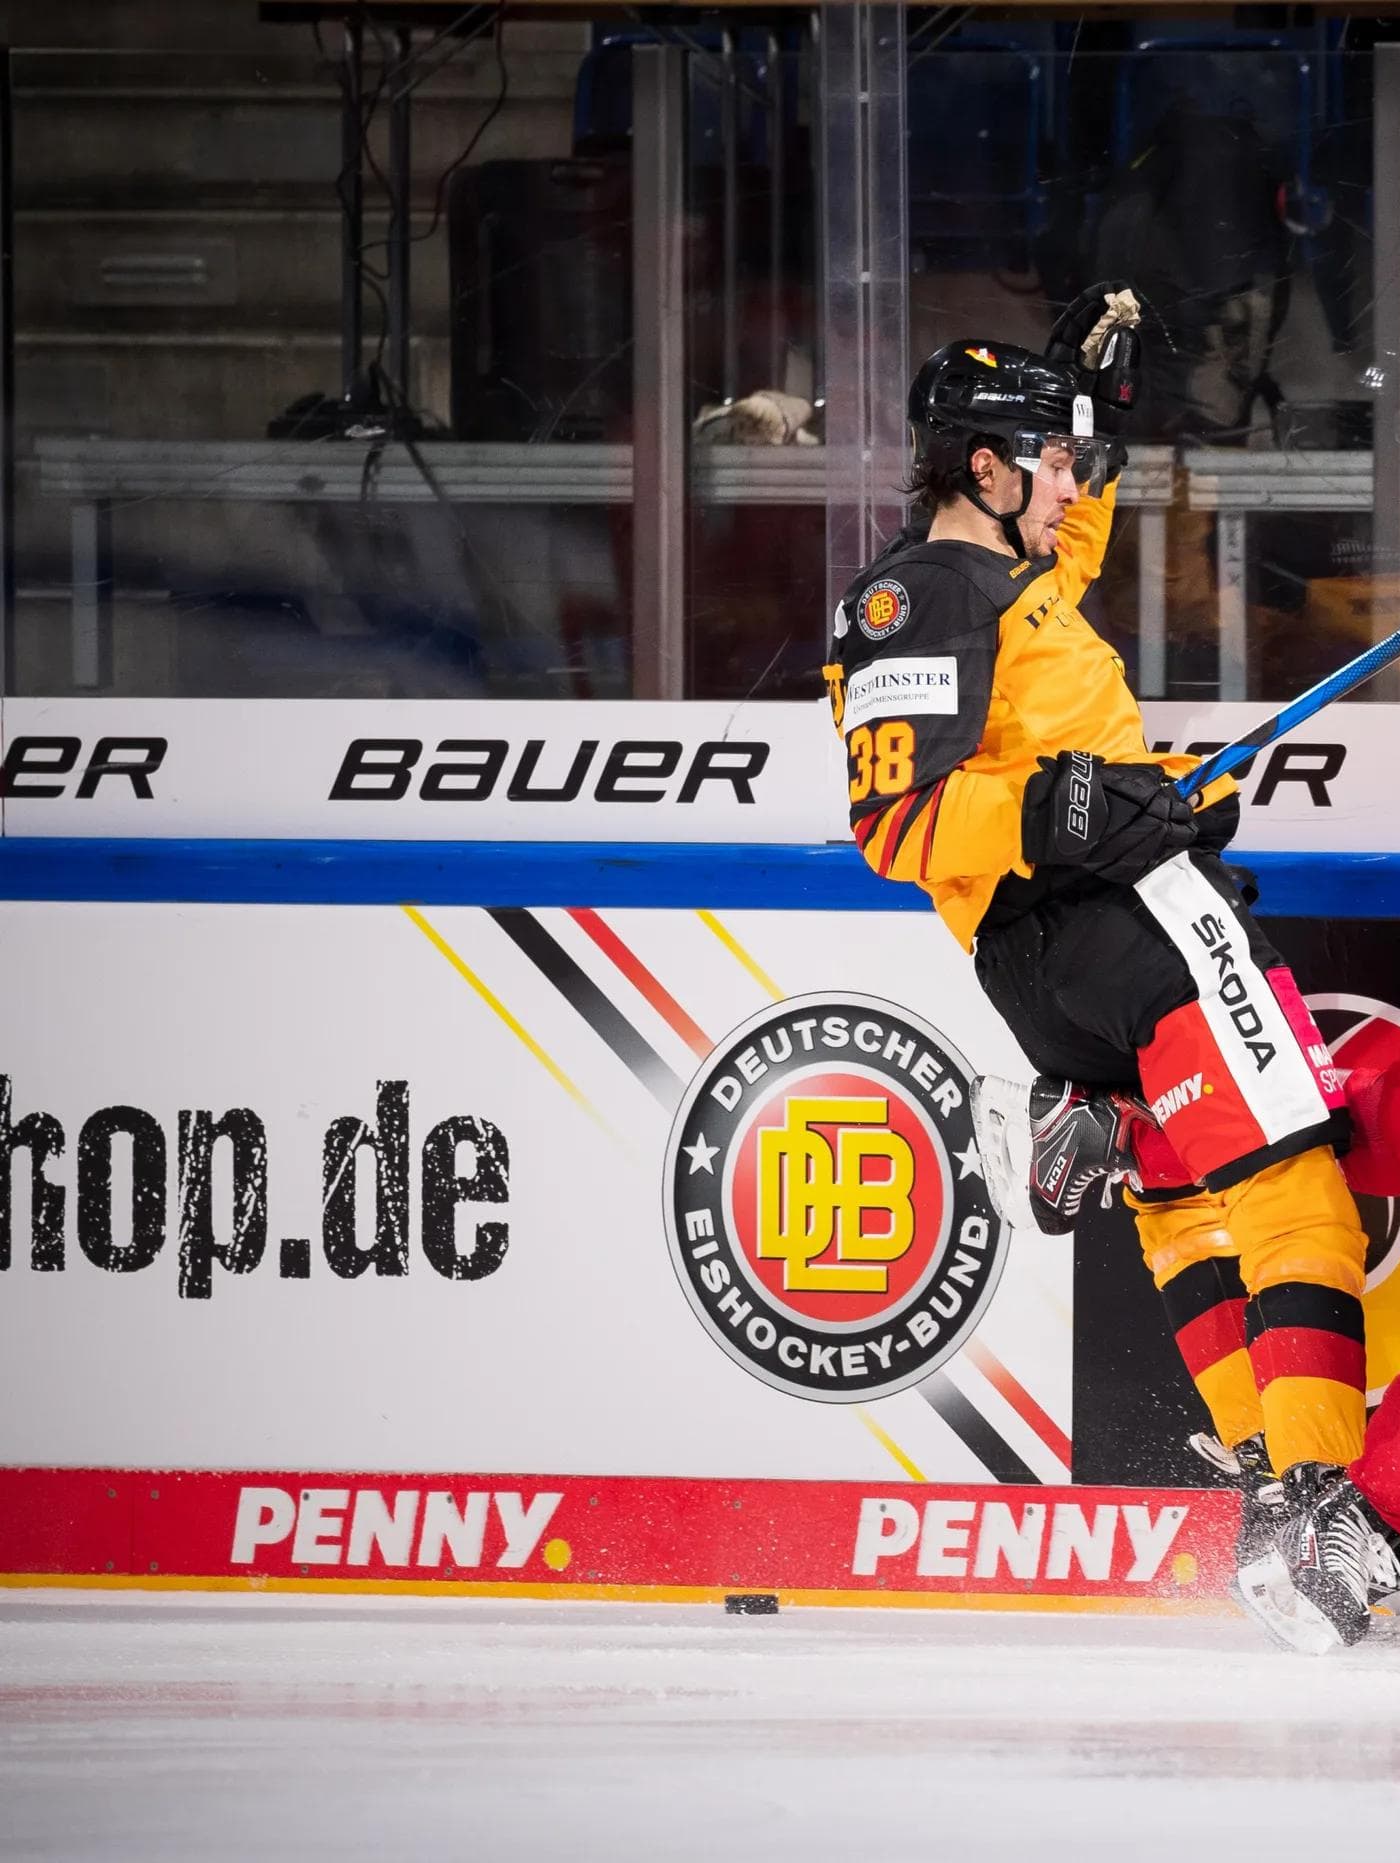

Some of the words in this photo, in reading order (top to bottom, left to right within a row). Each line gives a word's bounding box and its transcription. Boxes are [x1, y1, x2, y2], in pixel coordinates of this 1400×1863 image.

[2, 736, 168, 799] ER
[328, 738, 770, 804] BAUER
[850, 719, 915, 803] 38
[1191, 913, 1277, 1074] ŠKODA
[710, 1016, 963, 1118] DEUTSCHER
[0, 1074, 510, 1300] hop.de
[1046, 1155, 1068, 1193] CCM
[685, 1207, 992, 1378] EISHOCKEY-BUND
